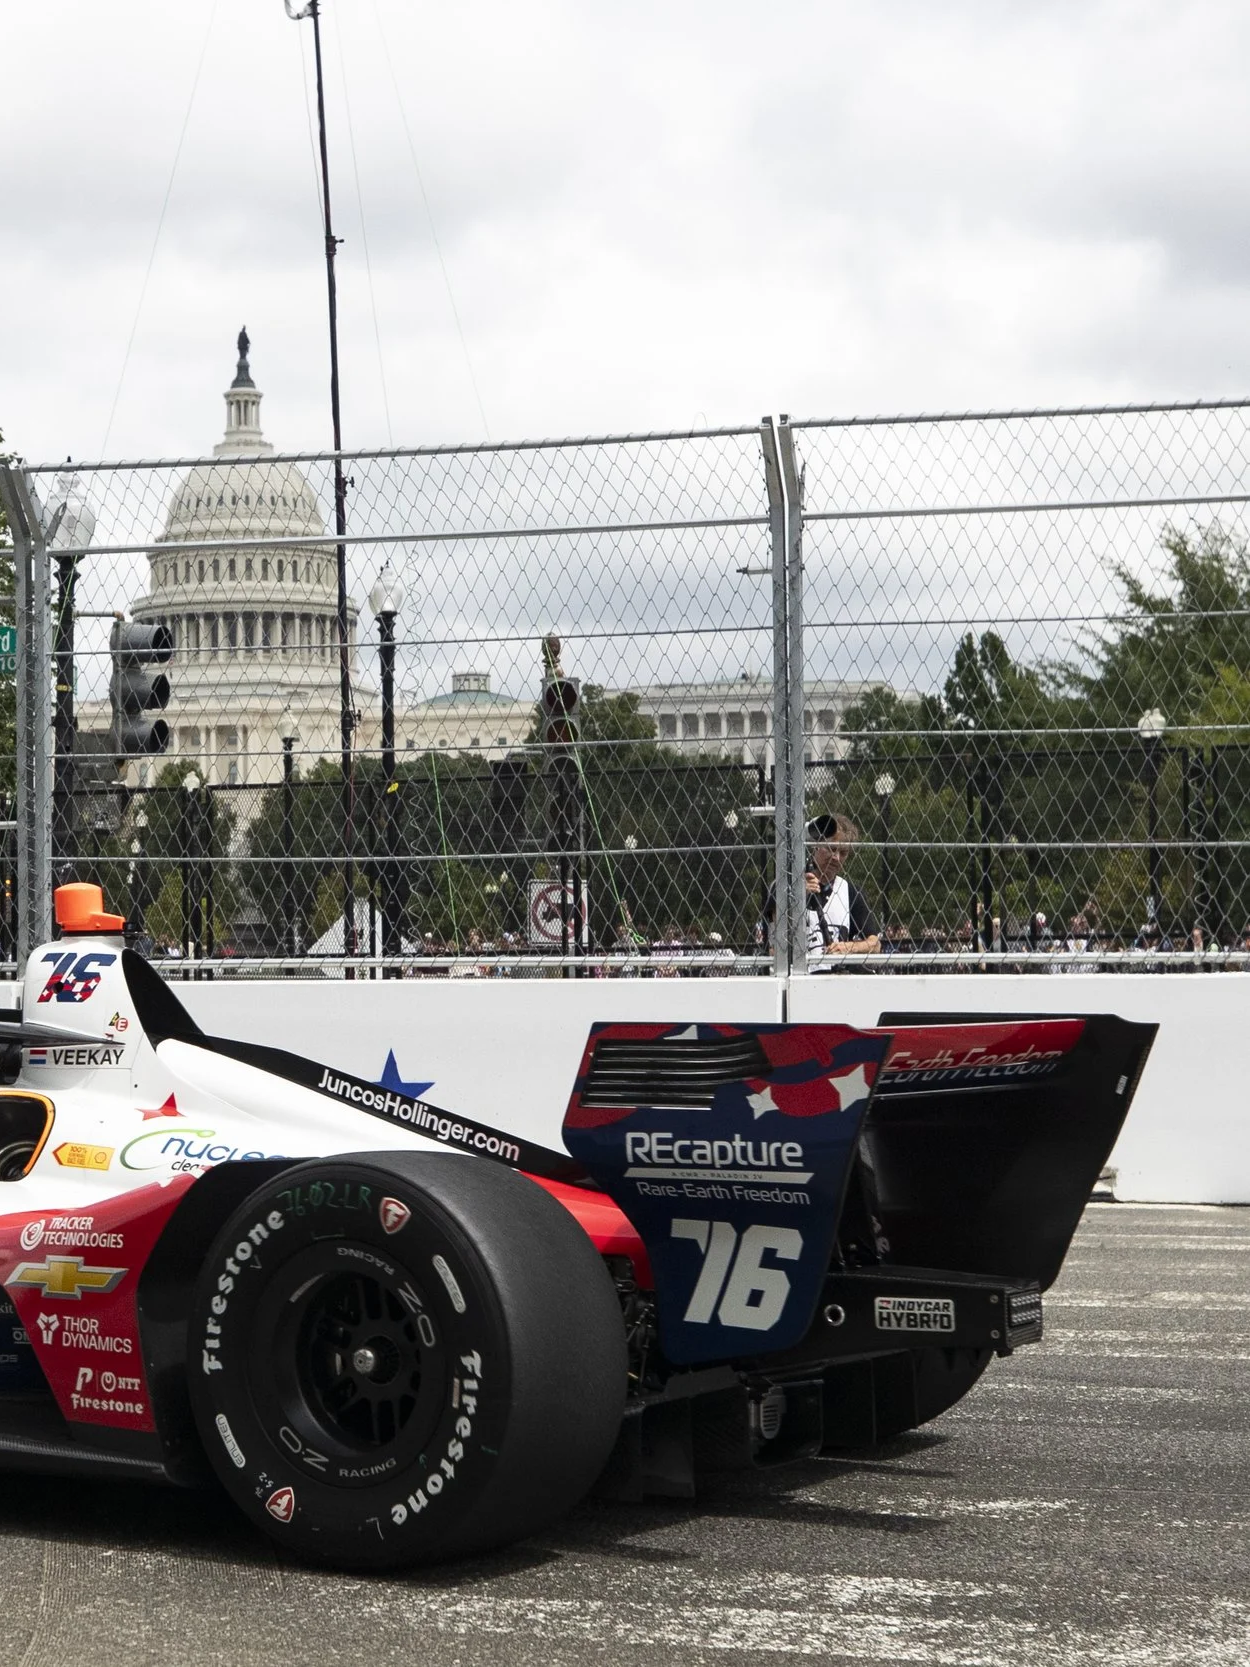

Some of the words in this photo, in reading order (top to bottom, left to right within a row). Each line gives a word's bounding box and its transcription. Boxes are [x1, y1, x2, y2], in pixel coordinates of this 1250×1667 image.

[37, 952, 117, 1003] 76
[53, 1049, 125, 1066] VEEKAY
[318, 1069, 520, 1162] JuncosHollinger.com
[160, 1137, 287, 1161] nucle
[625, 1131, 804, 1168] REcapture
[636, 1181, 731, 1200] Rare-Earth
[733, 1185, 811, 1206] Freedom
[49, 1216, 94, 1230] TRACKER
[43, 1231, 124, 1249] TECHNOLOGIES
[336, 1247, 395, 1276] RACING
[670, 1217, 805, 1332] 76
[202, 1209, 286, 1376] Firestone
[892, 1299, 950, 1313] INDYCAR
[62, 1315, 100, 1335] THOR
[878, 1311, 953, 1330] HYBRID
[62, 1331, 133, 1354] DYNAMICS
[118, 1377, 141, 1391] NTT
[71, 1393, 144, 1414] Firestone
[390, 1348, 483, 1526] Firestone
[338, 1456, 397, 1478] RACING
